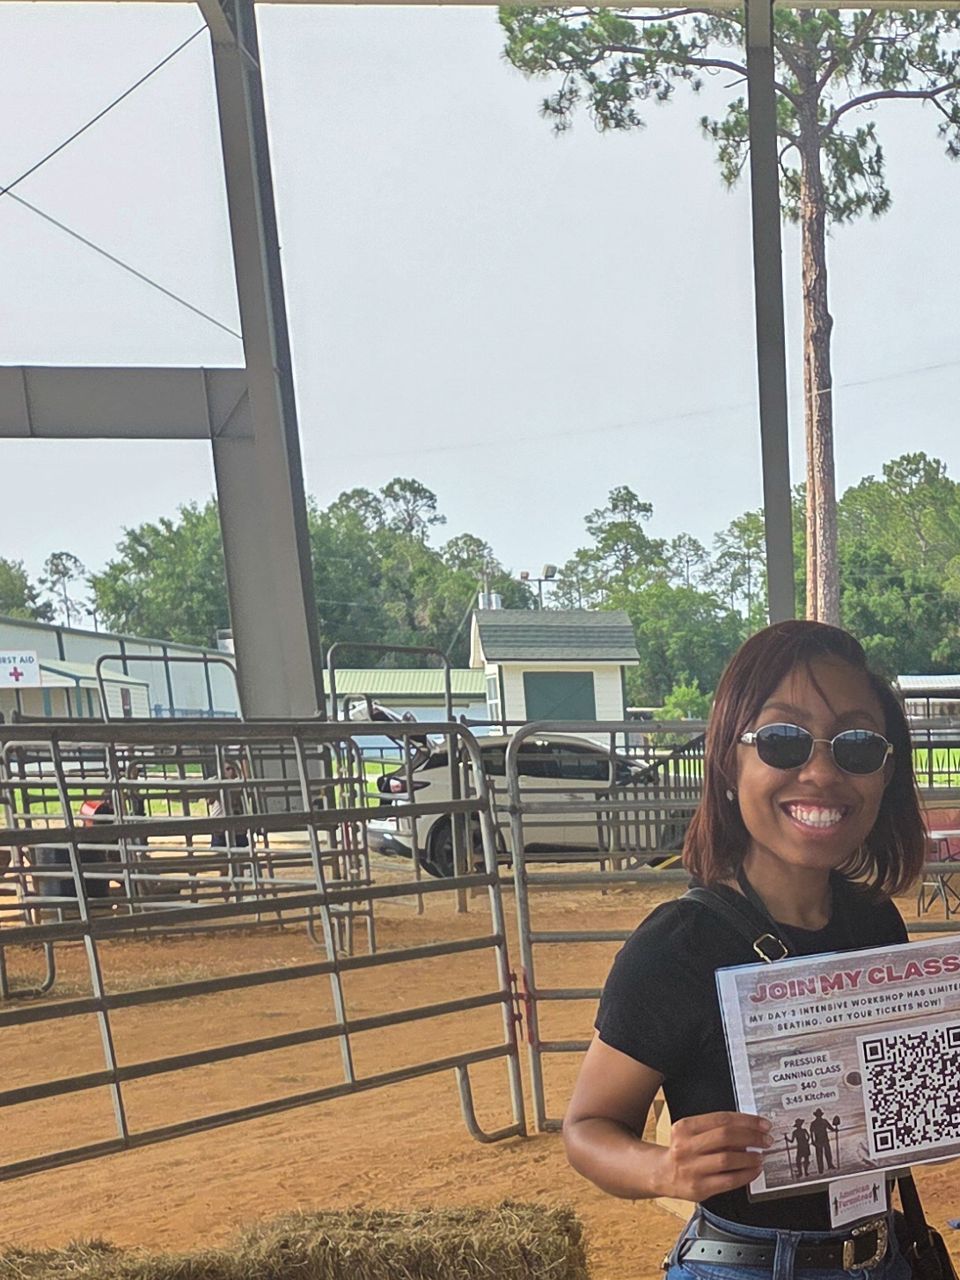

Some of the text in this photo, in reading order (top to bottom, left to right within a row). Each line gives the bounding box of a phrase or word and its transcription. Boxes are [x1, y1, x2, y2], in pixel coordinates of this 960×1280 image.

[0, 656, 35, 664] IRST AID
[750, 977, 817, 1003] JOIN
[819, 969, 863, 994] MY
[749, 1014, 763, 1023] MY
[800, 1001, 848, 1016] INTENSIVE
[851, 992, 904, 1007] WORKSHOP
[907, 988, 926, 998] HAS
[777, 998, 942, 1031] SEATING. GET YOUR TICKETS NOW!
[784, 1054, 828, 1068] PRESSURE
[772, 1064, 841, 1082] CANNING CLASS
[801, 1080, 817, 1090] $40
[785, 1091, 836, 1105] 3:45 Kitchen
